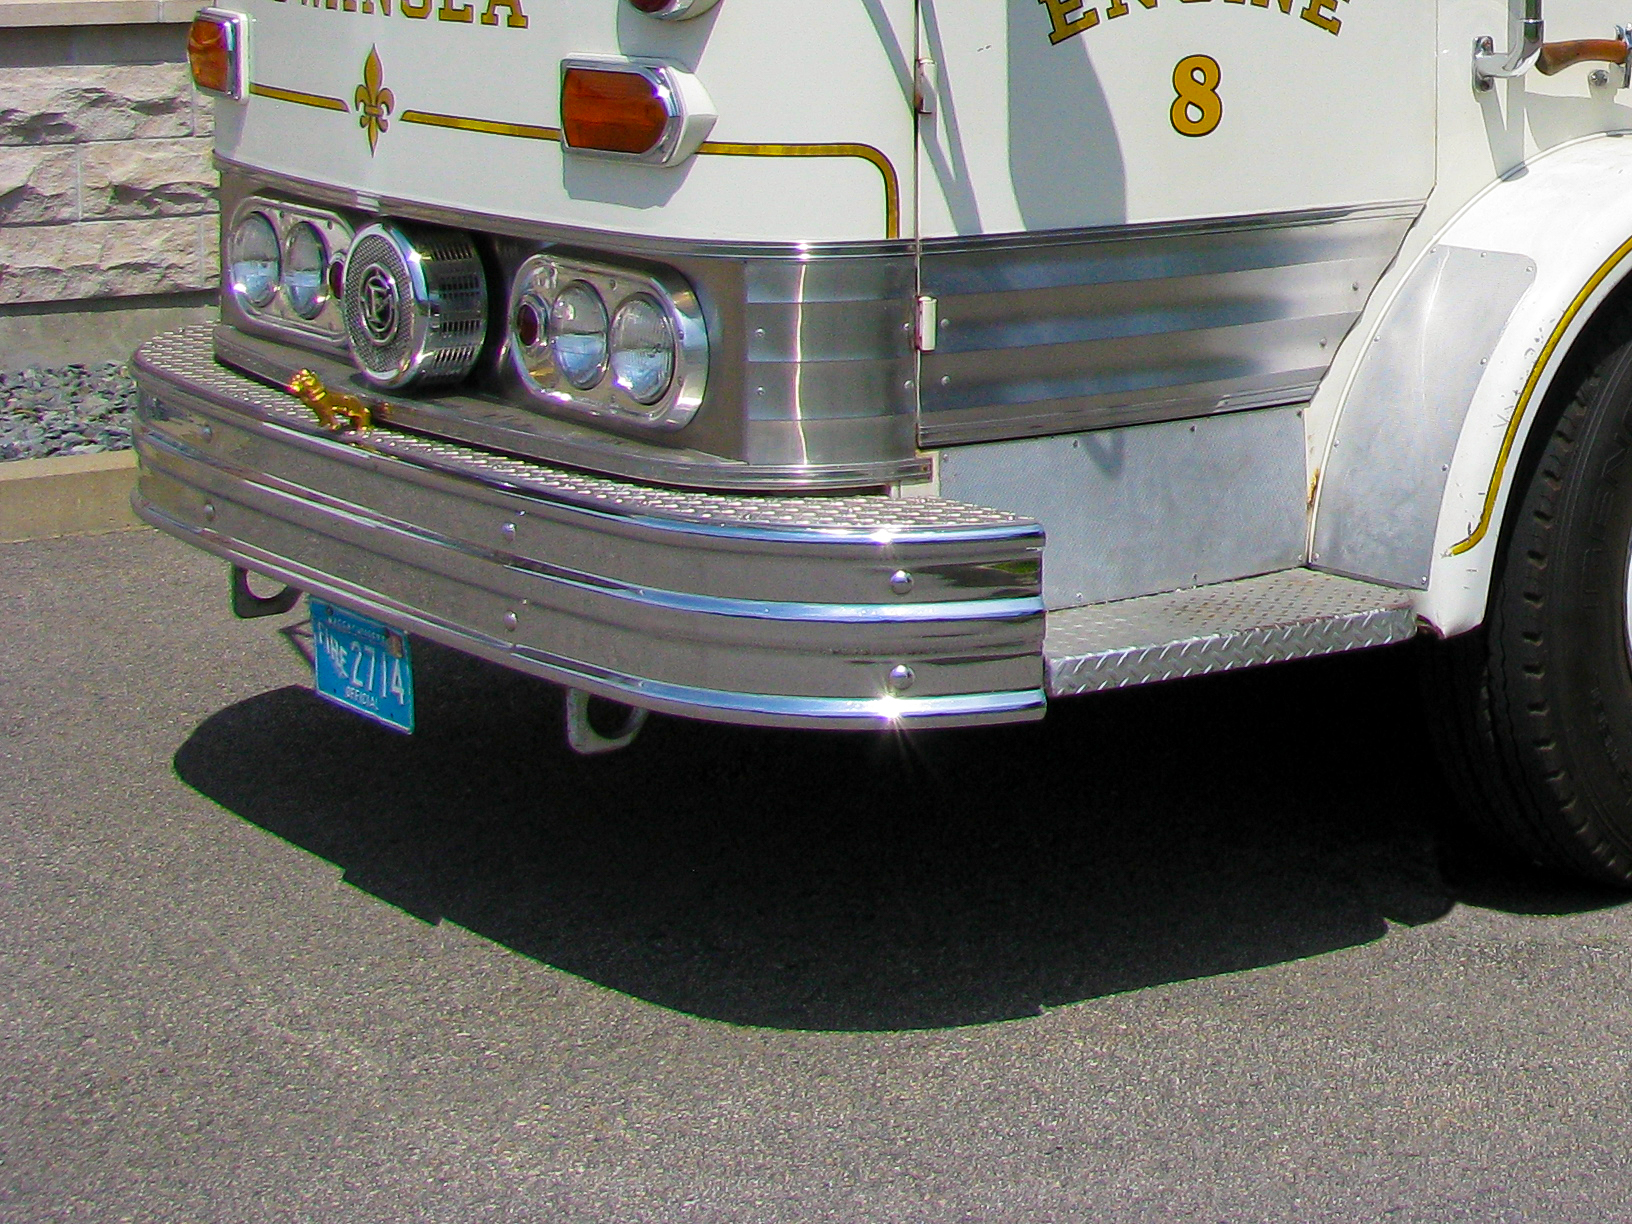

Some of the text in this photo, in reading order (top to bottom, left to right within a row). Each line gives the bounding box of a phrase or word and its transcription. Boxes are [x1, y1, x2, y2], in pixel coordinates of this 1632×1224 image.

[1169, 53, 1223, 138] 8
[344, 685, 380, 711] OFFICIAL
[350, 640, 405, 706] 2714
